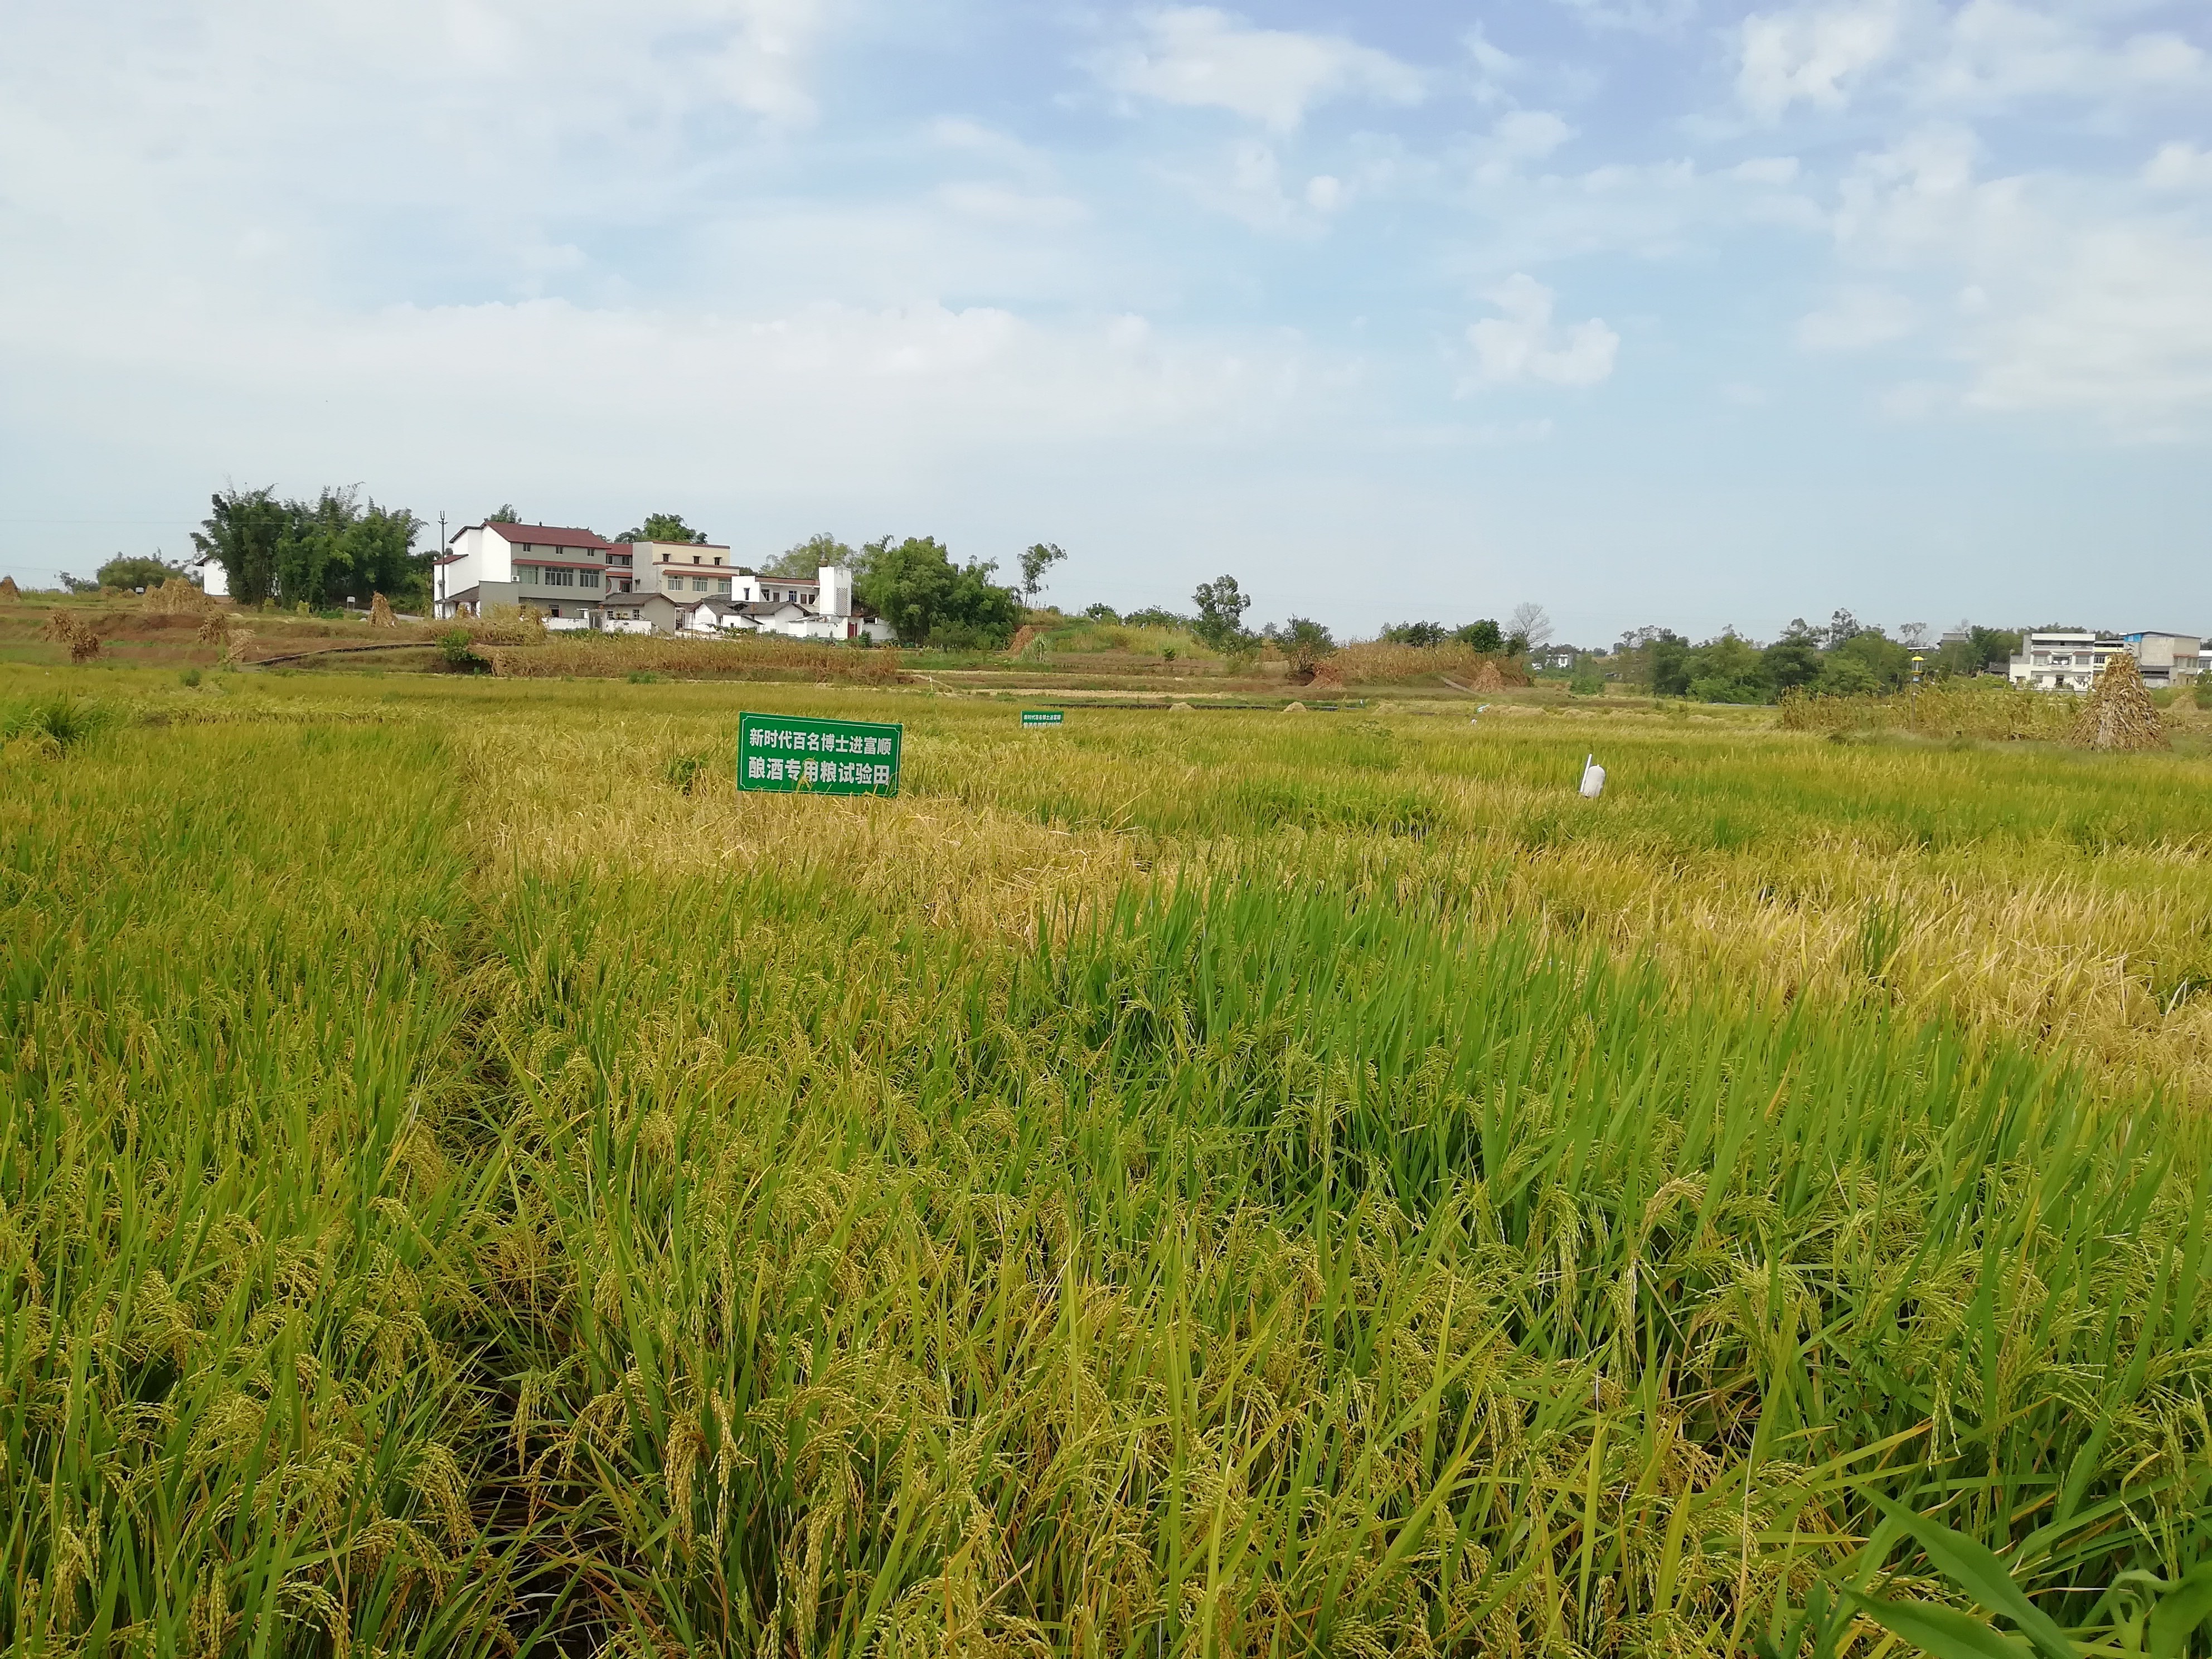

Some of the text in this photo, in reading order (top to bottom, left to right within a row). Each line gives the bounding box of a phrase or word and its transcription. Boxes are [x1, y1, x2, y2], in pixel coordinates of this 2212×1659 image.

[749, 727, 892, 755] 新时代百名博士进富顺
[748, 756, 890, 785] 酿酒专用粮试验田
